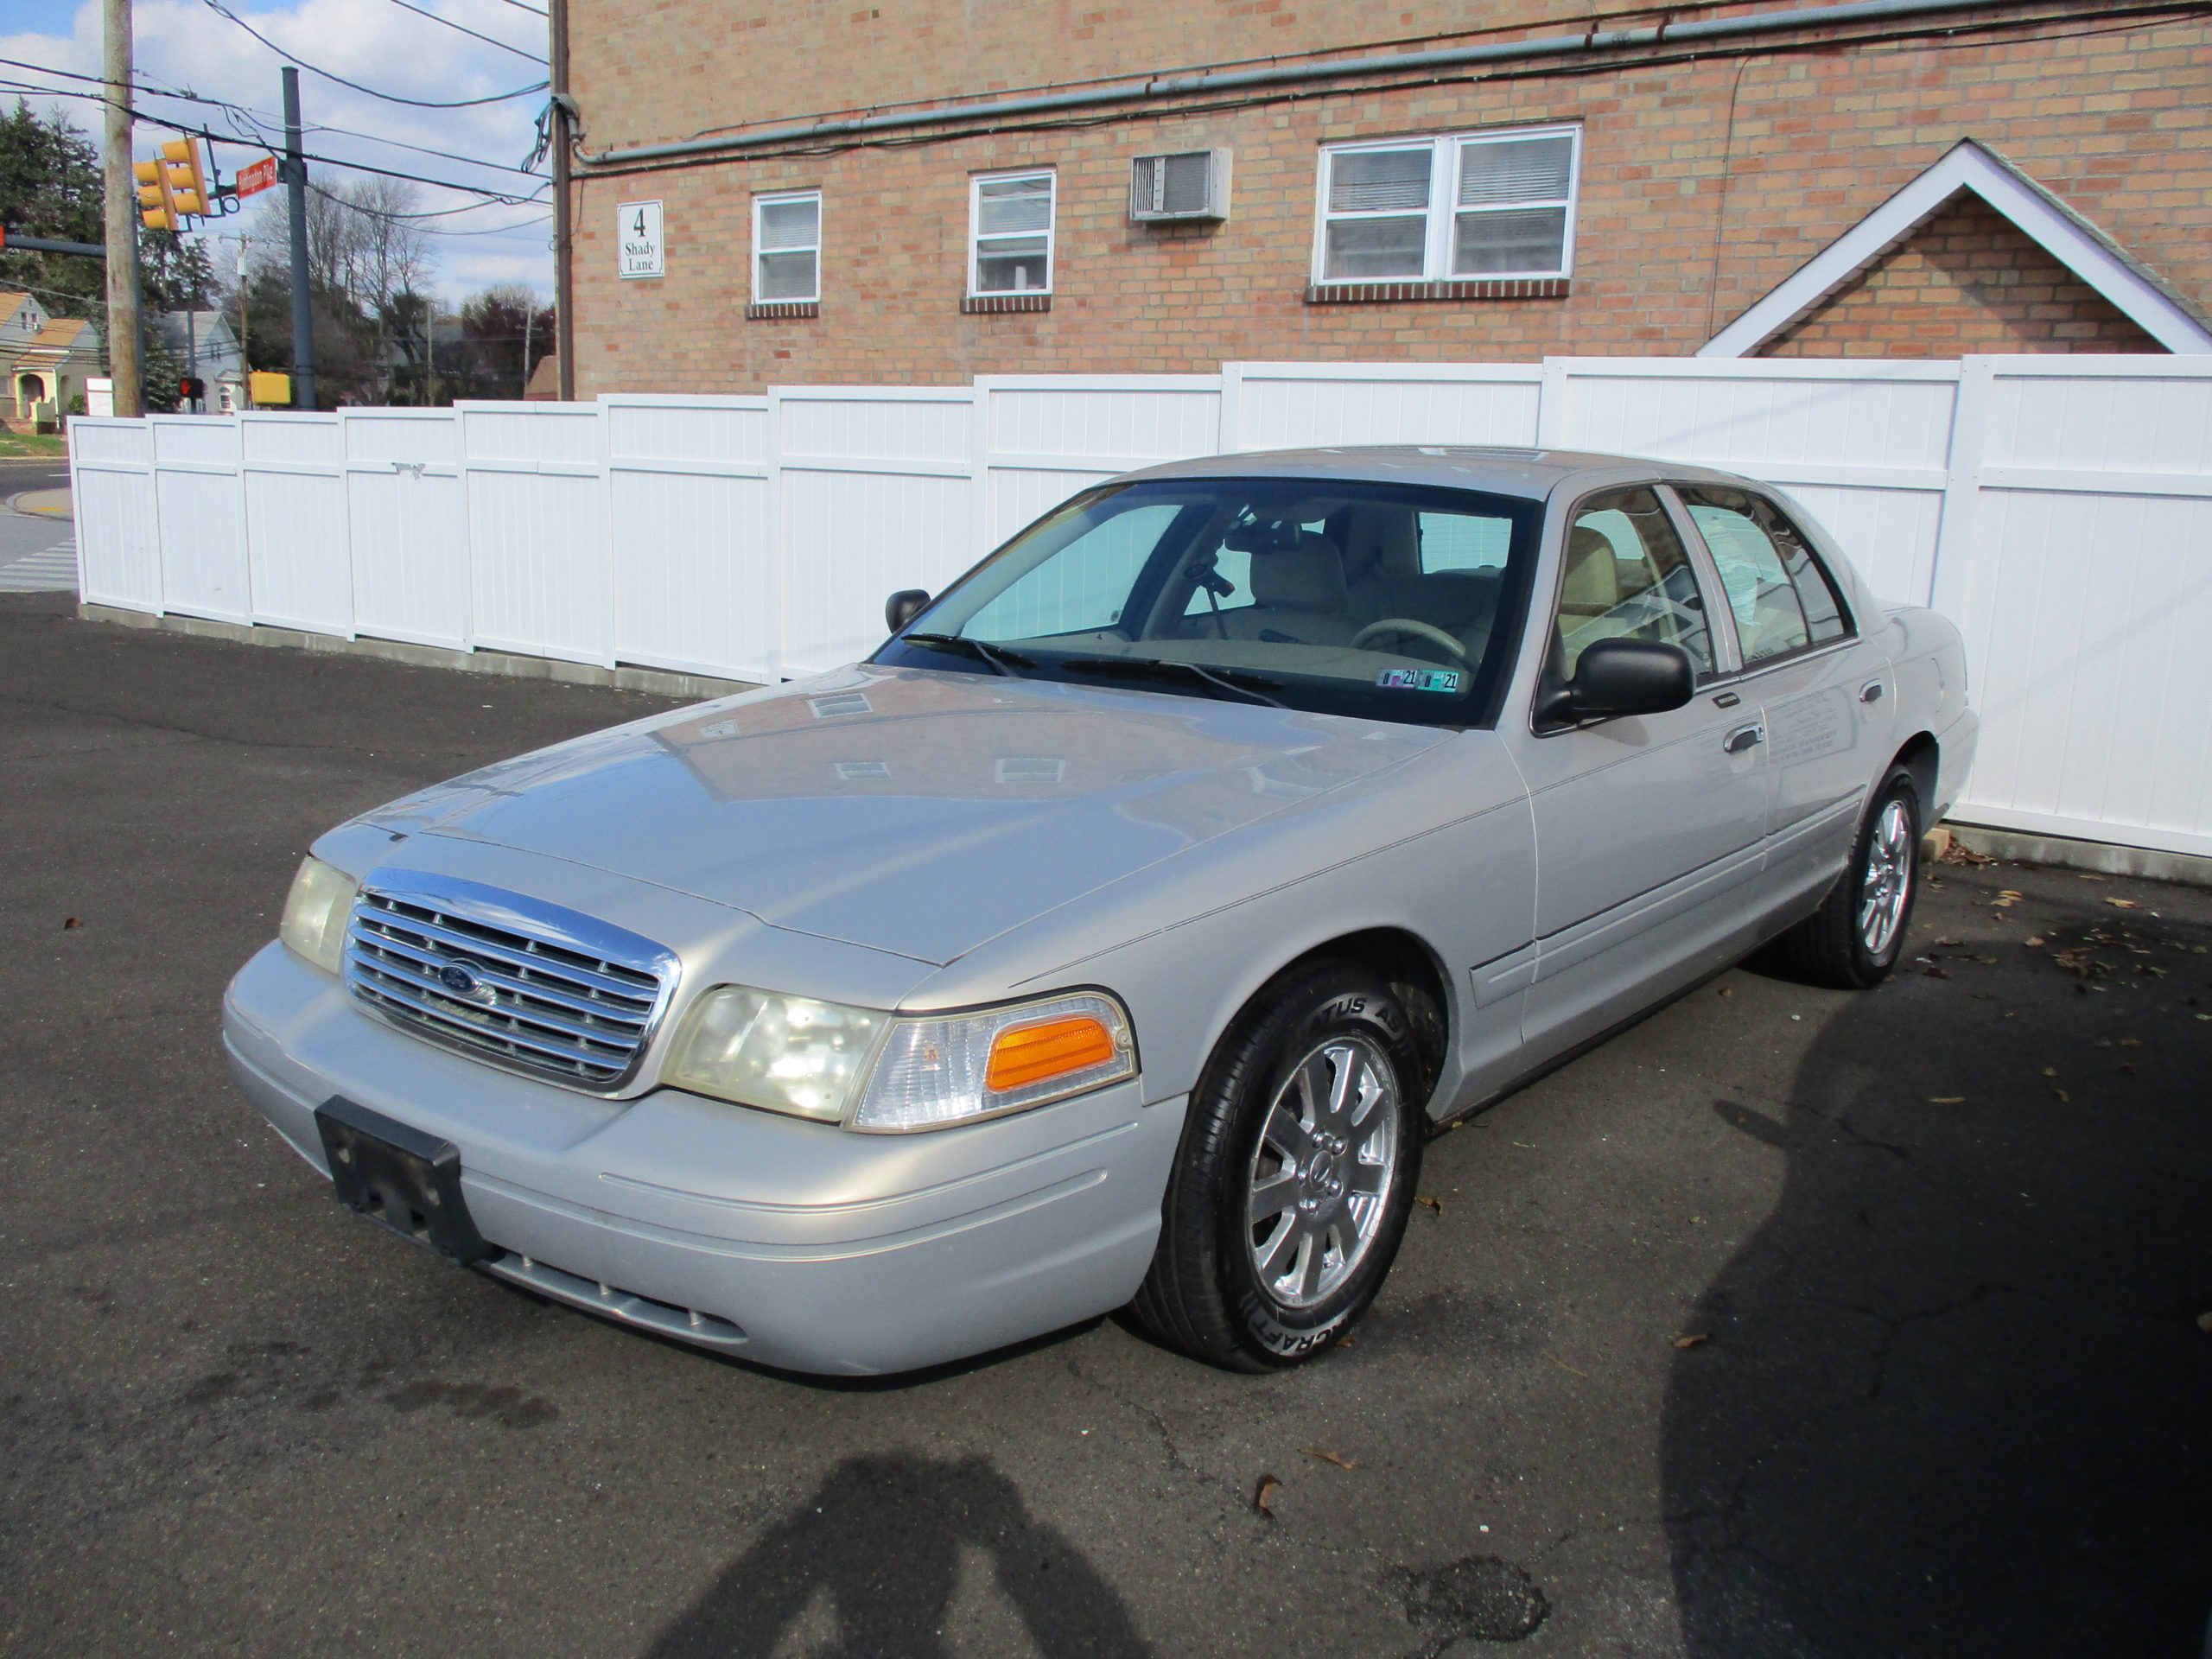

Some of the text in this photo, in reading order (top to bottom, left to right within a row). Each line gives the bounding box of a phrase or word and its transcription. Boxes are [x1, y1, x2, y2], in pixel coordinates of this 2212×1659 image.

[263, 164, 274, 181] Pike
[633, 207, 645, 238] 4
[625, 242, 655, 257] Shady
[629, 258, 653, 271] Lane
[1382, 672, 1390, 685] 8
[1425, 675, 1432, 687] 8
